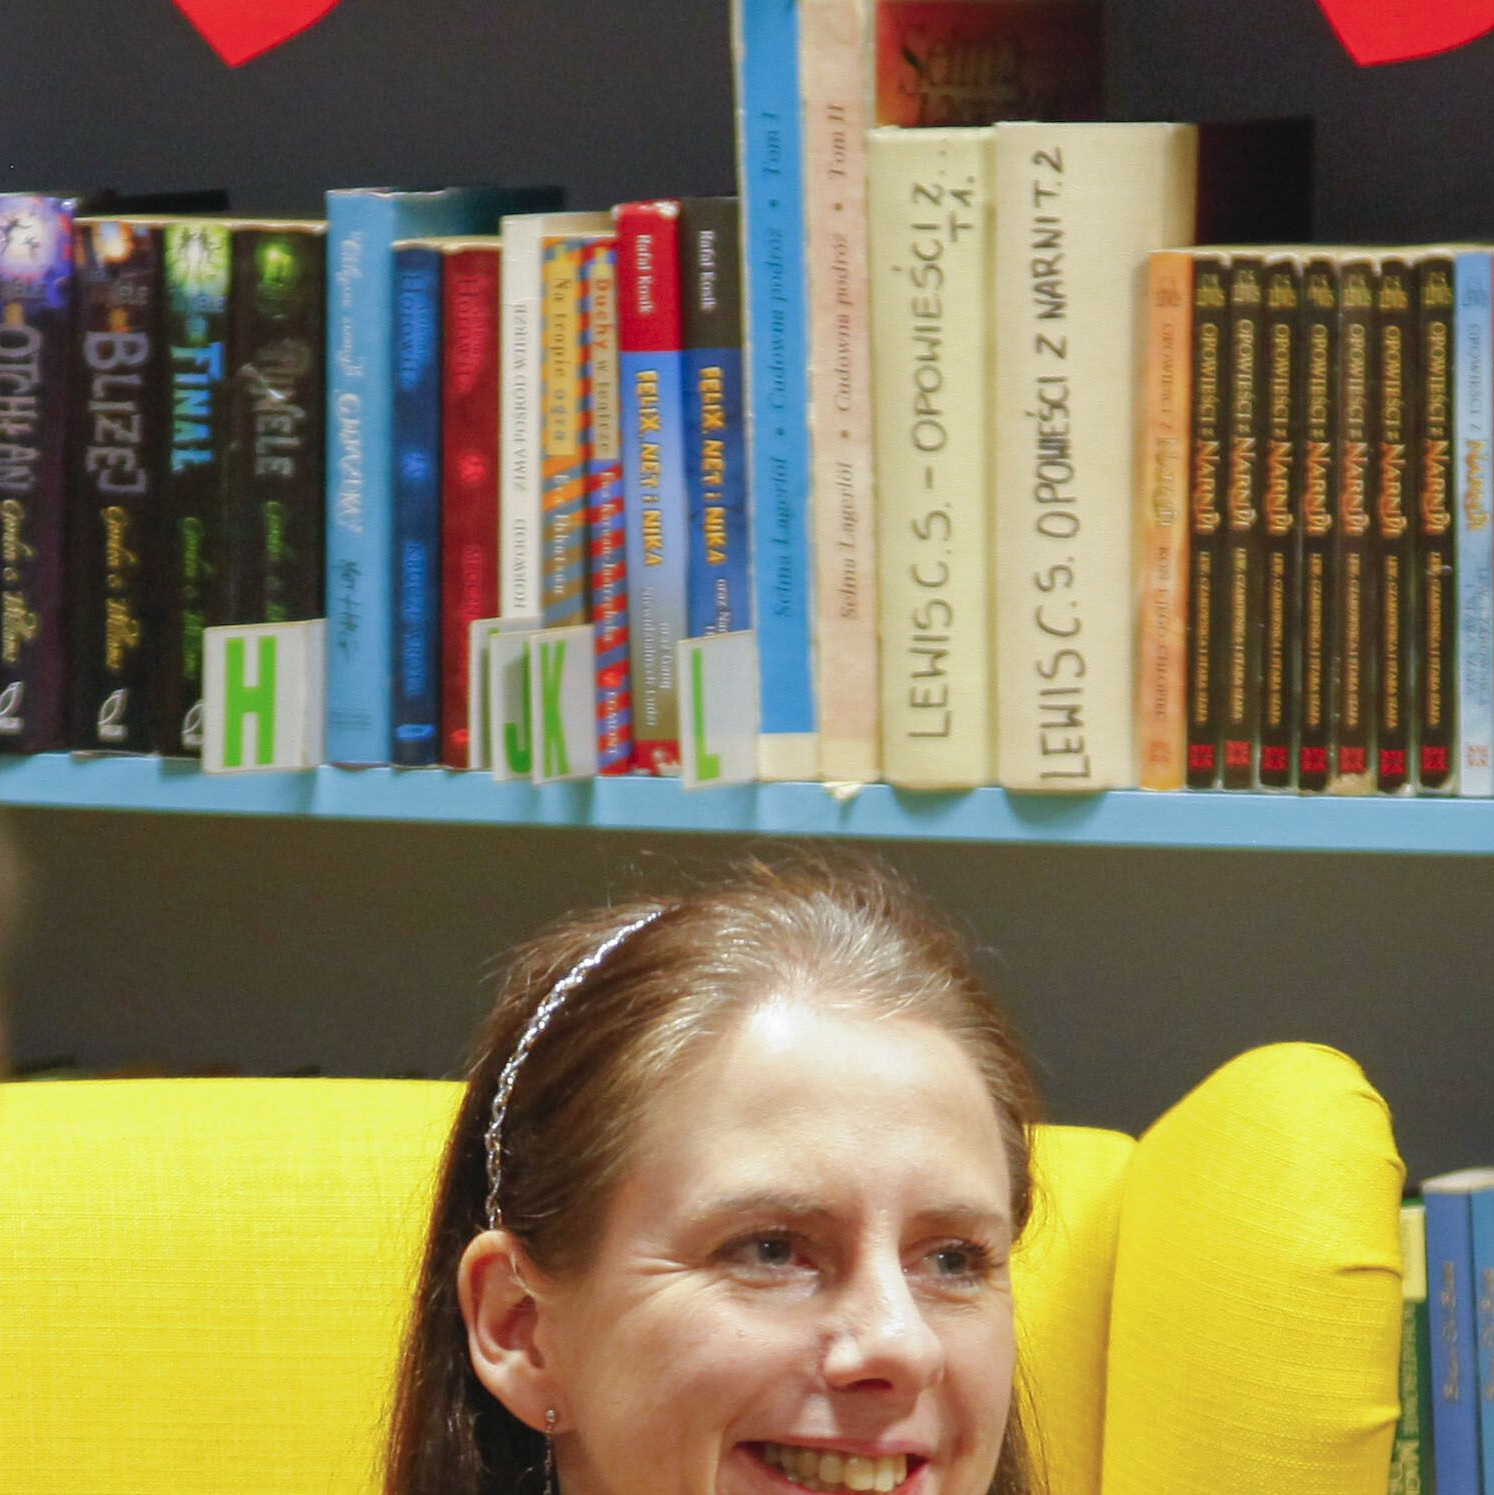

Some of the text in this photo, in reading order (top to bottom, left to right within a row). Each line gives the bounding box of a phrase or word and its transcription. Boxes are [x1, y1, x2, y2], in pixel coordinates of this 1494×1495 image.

[761, 130, 782, 177] Tom
[825, 103, 845, 125] II
[826, 130, 847, 180] Tom
[636, 233, 656, 315] Rafał Kosik
[698, 229, 717, 311] Rafał Kosik
[1029, 216, 1068, 321] NARNI
[590, 278, 612, 351] Duchy
[894, 223, 947, 452] OPOWIEŚCI
[1034, 333, 1067, 361] Z
[549, 277, 570, 442] Na tropie ogra
[698, 366, 726, 435] FELIX,
[766, 309, 787, 412] Cudowna
[831, 313, 852, 413] Cudowna
[1198, 322, 1220, 423] OPOWIEŚCI
[1236, 319, 1258, 418] OPOWIEŚCI
[1271, 323, 1292, 424] OPOWIEŚCI
[1310, 324, 1331, 424] OPOWIEŚCI
[1346, 323, 1368, 424] OPOWIEŚCI
[1382, 325, 1403, 426] OPOWIEŚCI
[1425, 321, 1449, 424] OPOWIEŚCI
[596, 381, 613, 453] teatrze
[635, 370, 661, 439] FELIX,
[512, 448, 527, 491] ZIMA
[600, 471, 616, 499] Ewa
[639, 443, 661, 489] NET
[700, 439, 727, 487] NET
[1024, 375, 1081, 540] OPOWIEŚCI
[102, 505, 137, 567] Gordon
[512, 518, 527, 609] HORWOOD
[642, 509, 664, 568] NIKA
[702, 506, 727, 566] NIKA
[1, 590, 38, 665] Williams
[715, 578, 730, 607] oraz
[770, 554, 794, 619] Selma
[837, 557, 860, 620] Selma
[104, 597, 139, 672] Williams
[641, 586, 658, 727] Niewidzialnych Ludzi
[658, 622, 673, 690] oraz Gang
[907, 598, 954, 738] LEWIS
[223, 634, 278, 768] H
[503, 640, 532, 775] J
[539, 639, 570, 778] K
[605, 691, 619, 756] EGMONT
[691, 647, 721, 781] L
[1035, 648, 1092, 781] LEWIS
